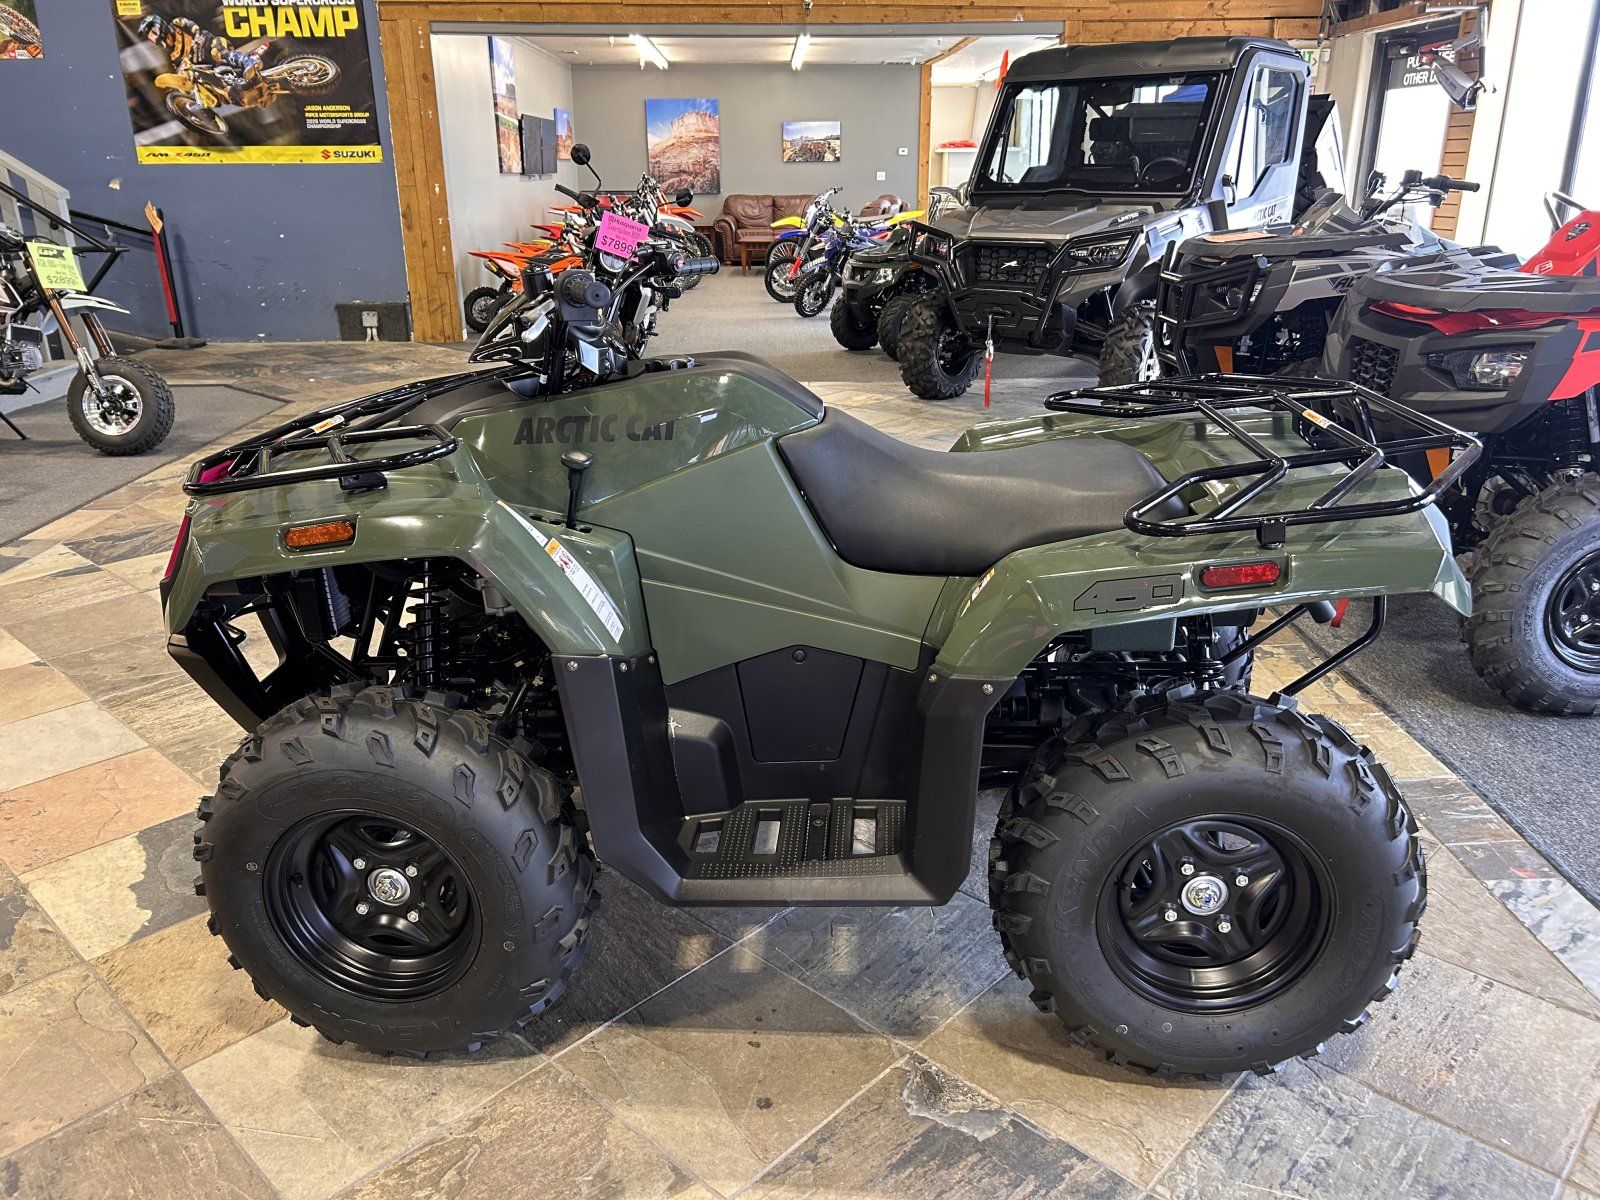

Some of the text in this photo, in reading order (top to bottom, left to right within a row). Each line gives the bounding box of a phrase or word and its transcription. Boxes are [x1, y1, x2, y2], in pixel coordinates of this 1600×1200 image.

[223, 5, 360, 38] CHAMP
[1403, 72, 1428, 86] OTHER
[333, 150, 376, 158] SUZUKI
[513, 411, 682, 445] ARCTIC CAT
